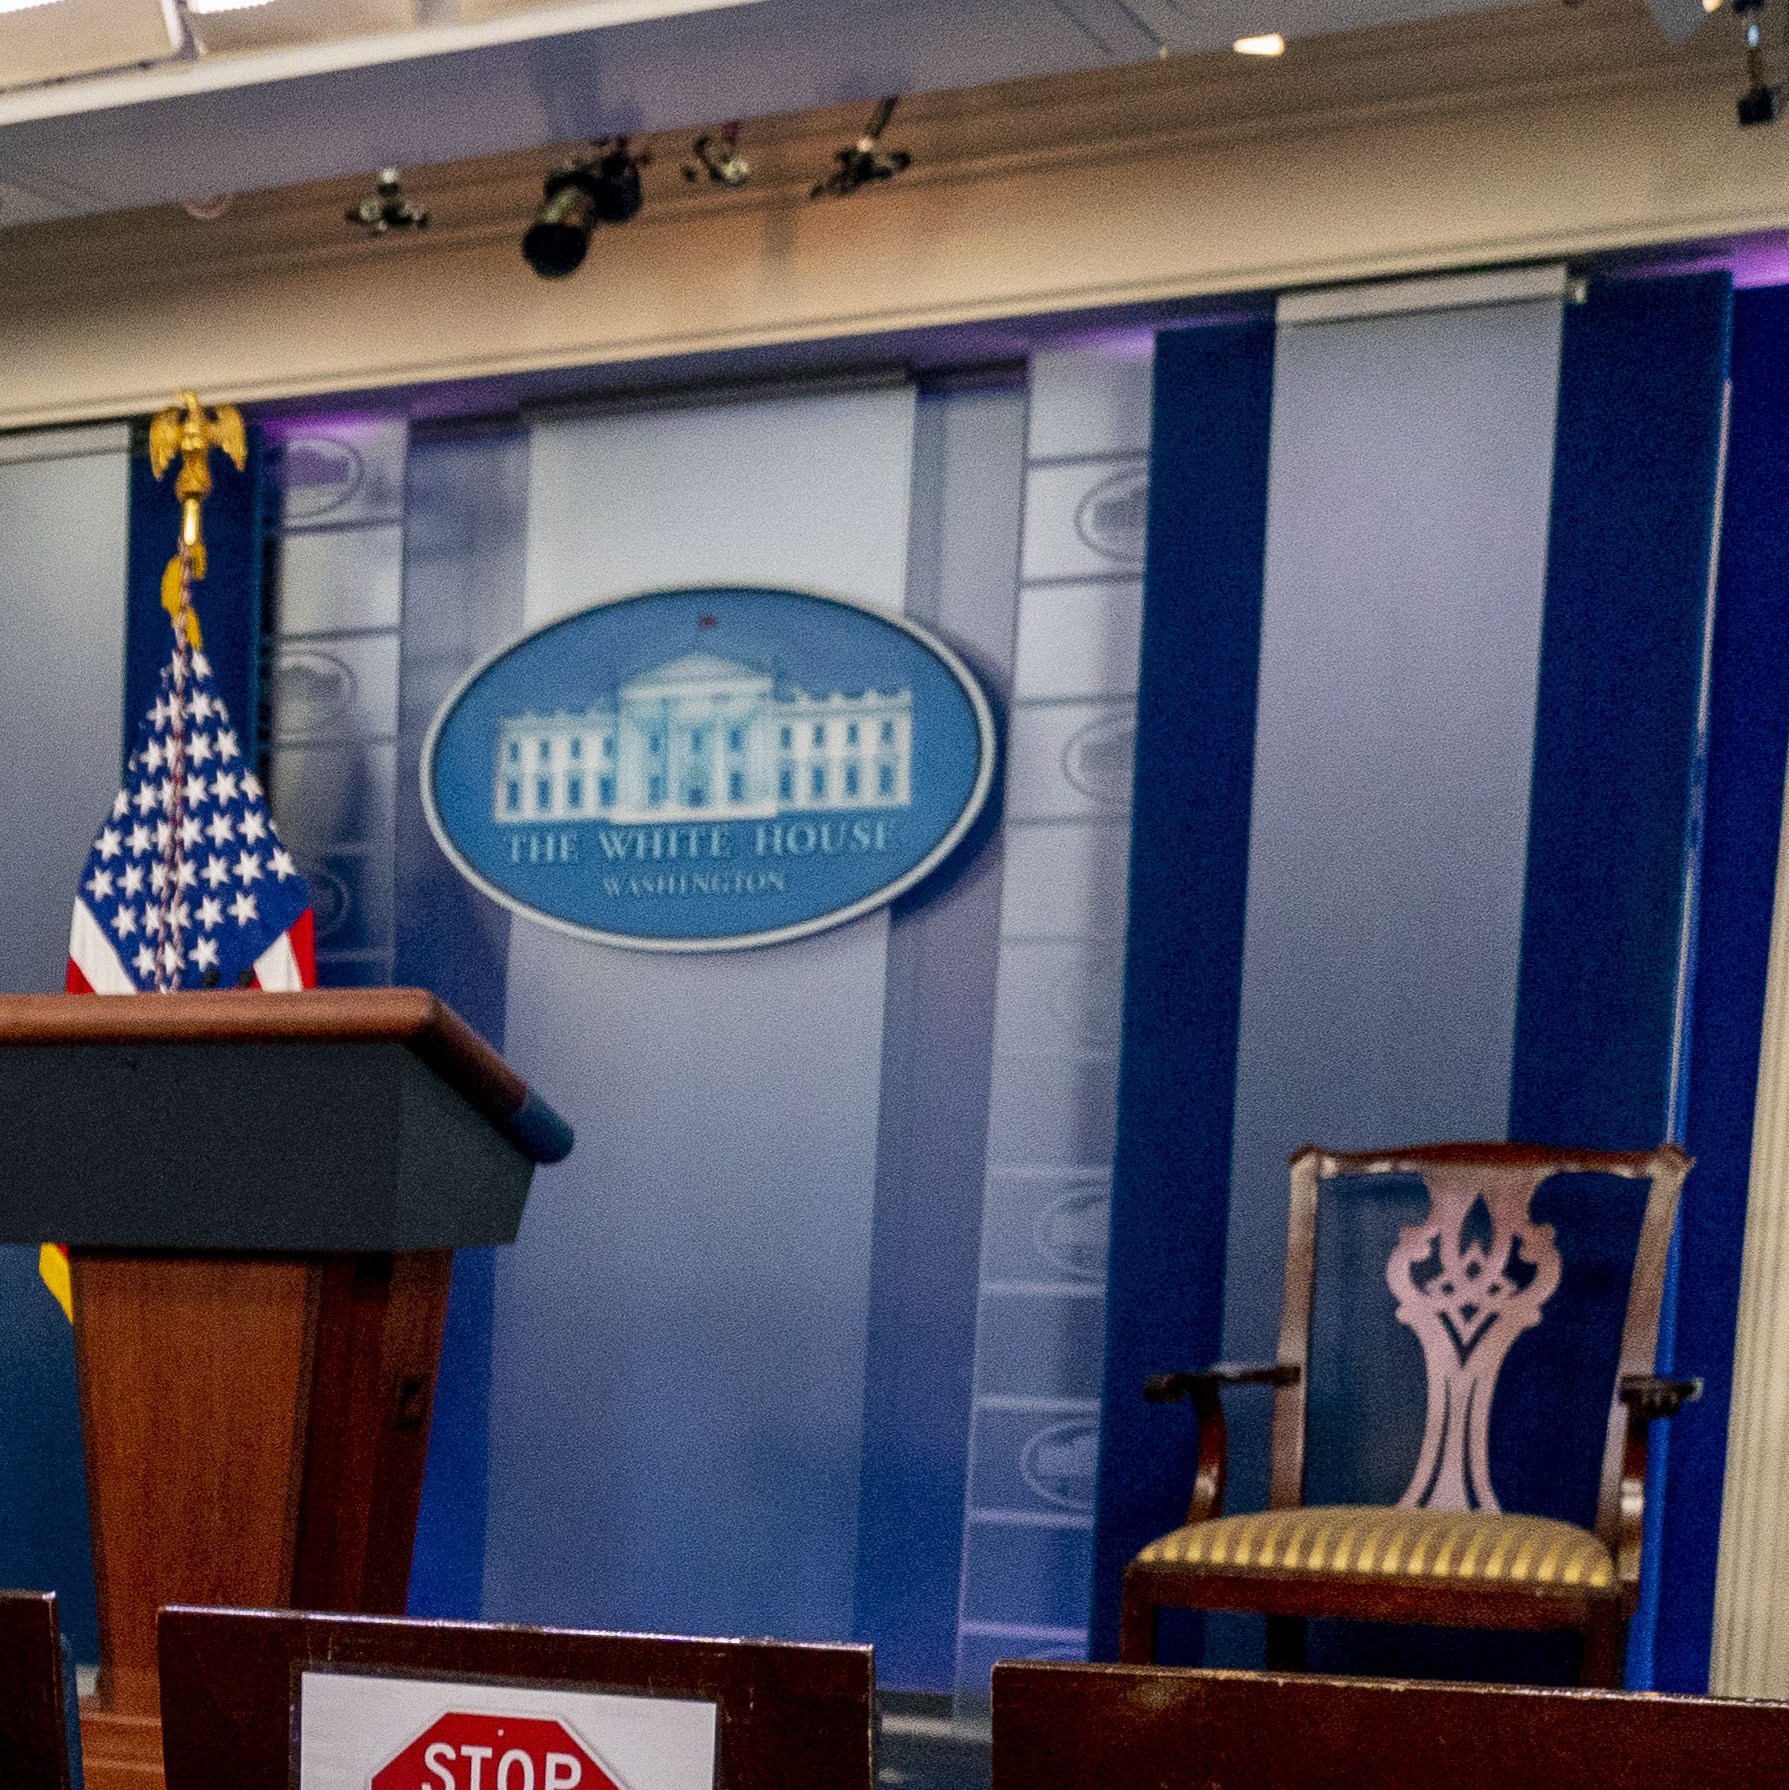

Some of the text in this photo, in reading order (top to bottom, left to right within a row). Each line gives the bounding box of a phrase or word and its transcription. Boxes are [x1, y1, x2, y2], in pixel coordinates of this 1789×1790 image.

[506, 819, 894, 864] THE WHITE HOUSE
[603, 870, 786, 896] WASHINGTON
